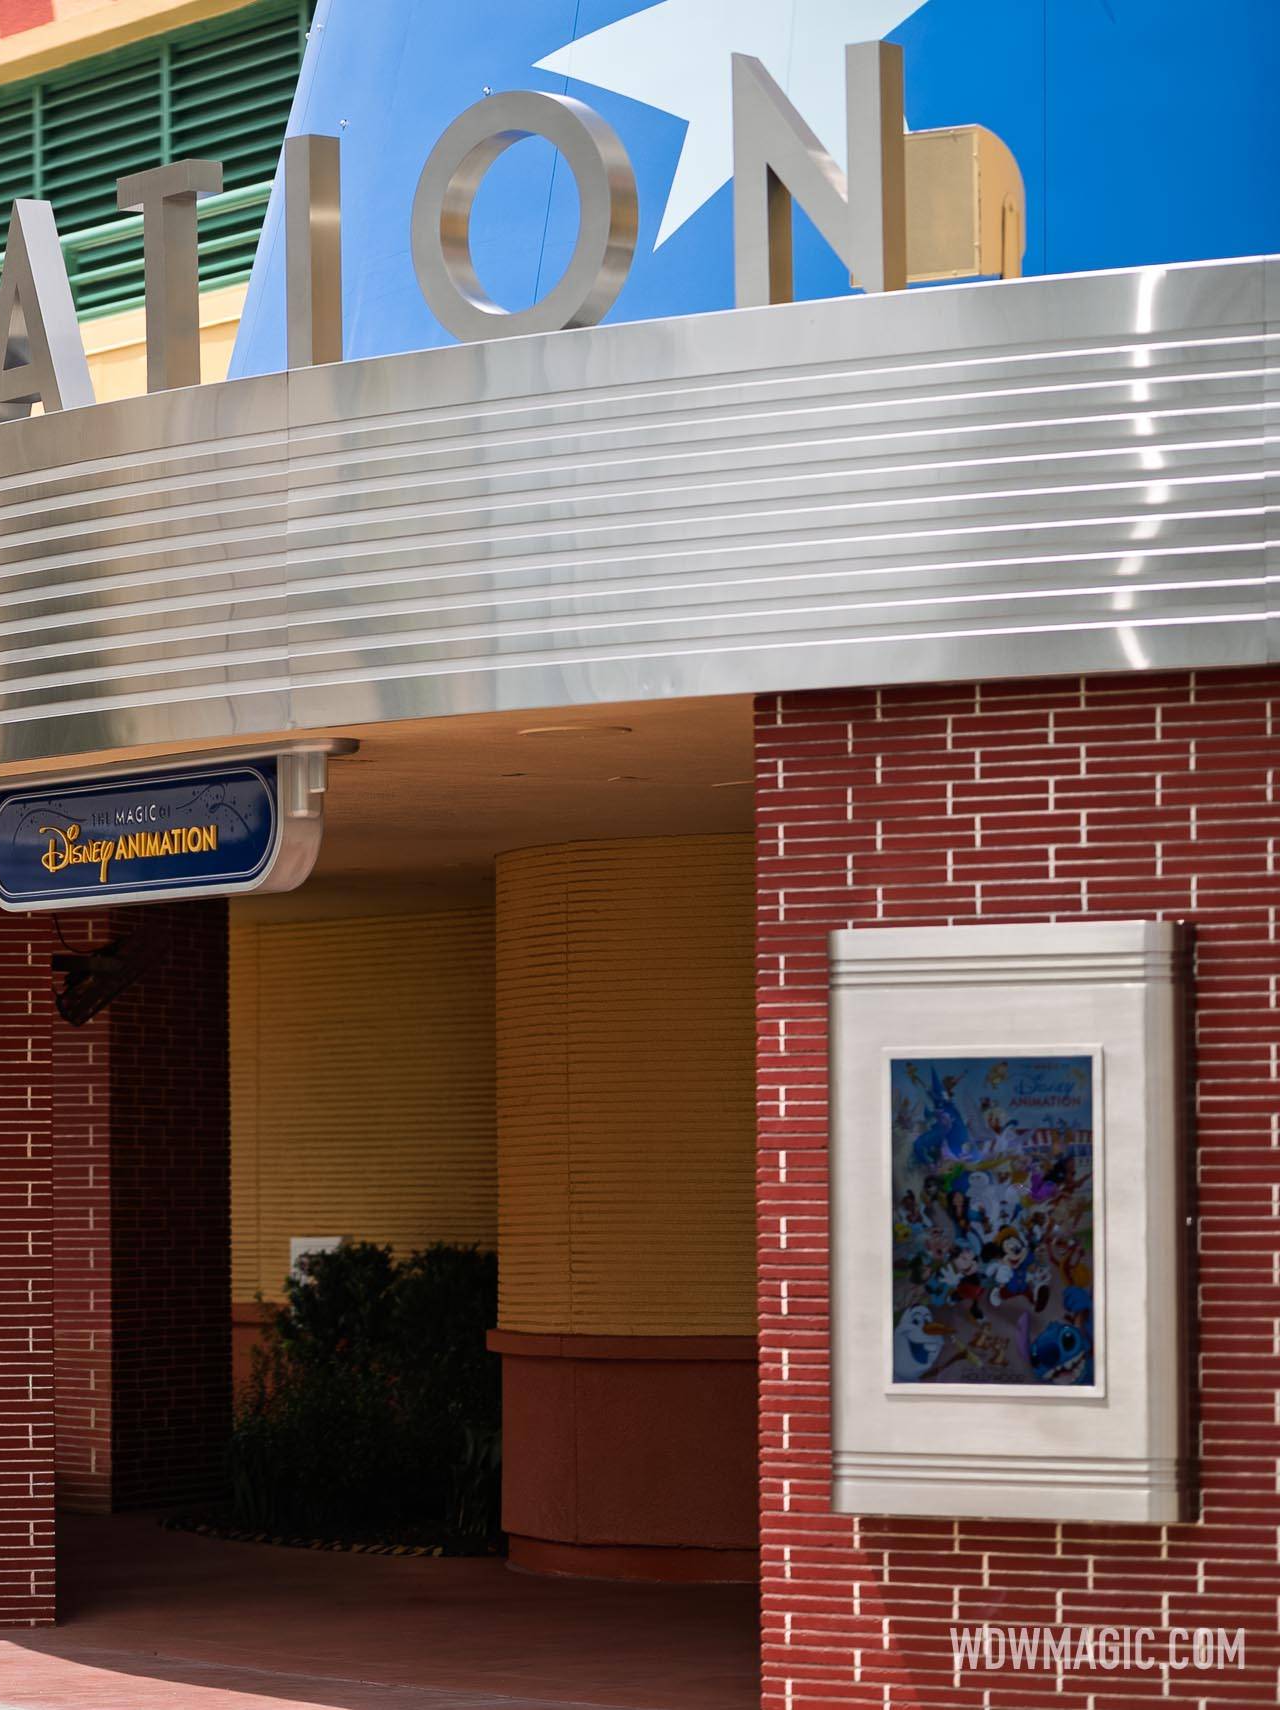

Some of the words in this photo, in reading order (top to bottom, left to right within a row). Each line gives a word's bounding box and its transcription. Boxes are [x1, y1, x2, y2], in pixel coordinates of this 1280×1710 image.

[116, 804, 156, 825] MAGIC
[115, 825, 218, 861] ANIMATION
[1009, 1095, 1082, 1108] ANIMATION
